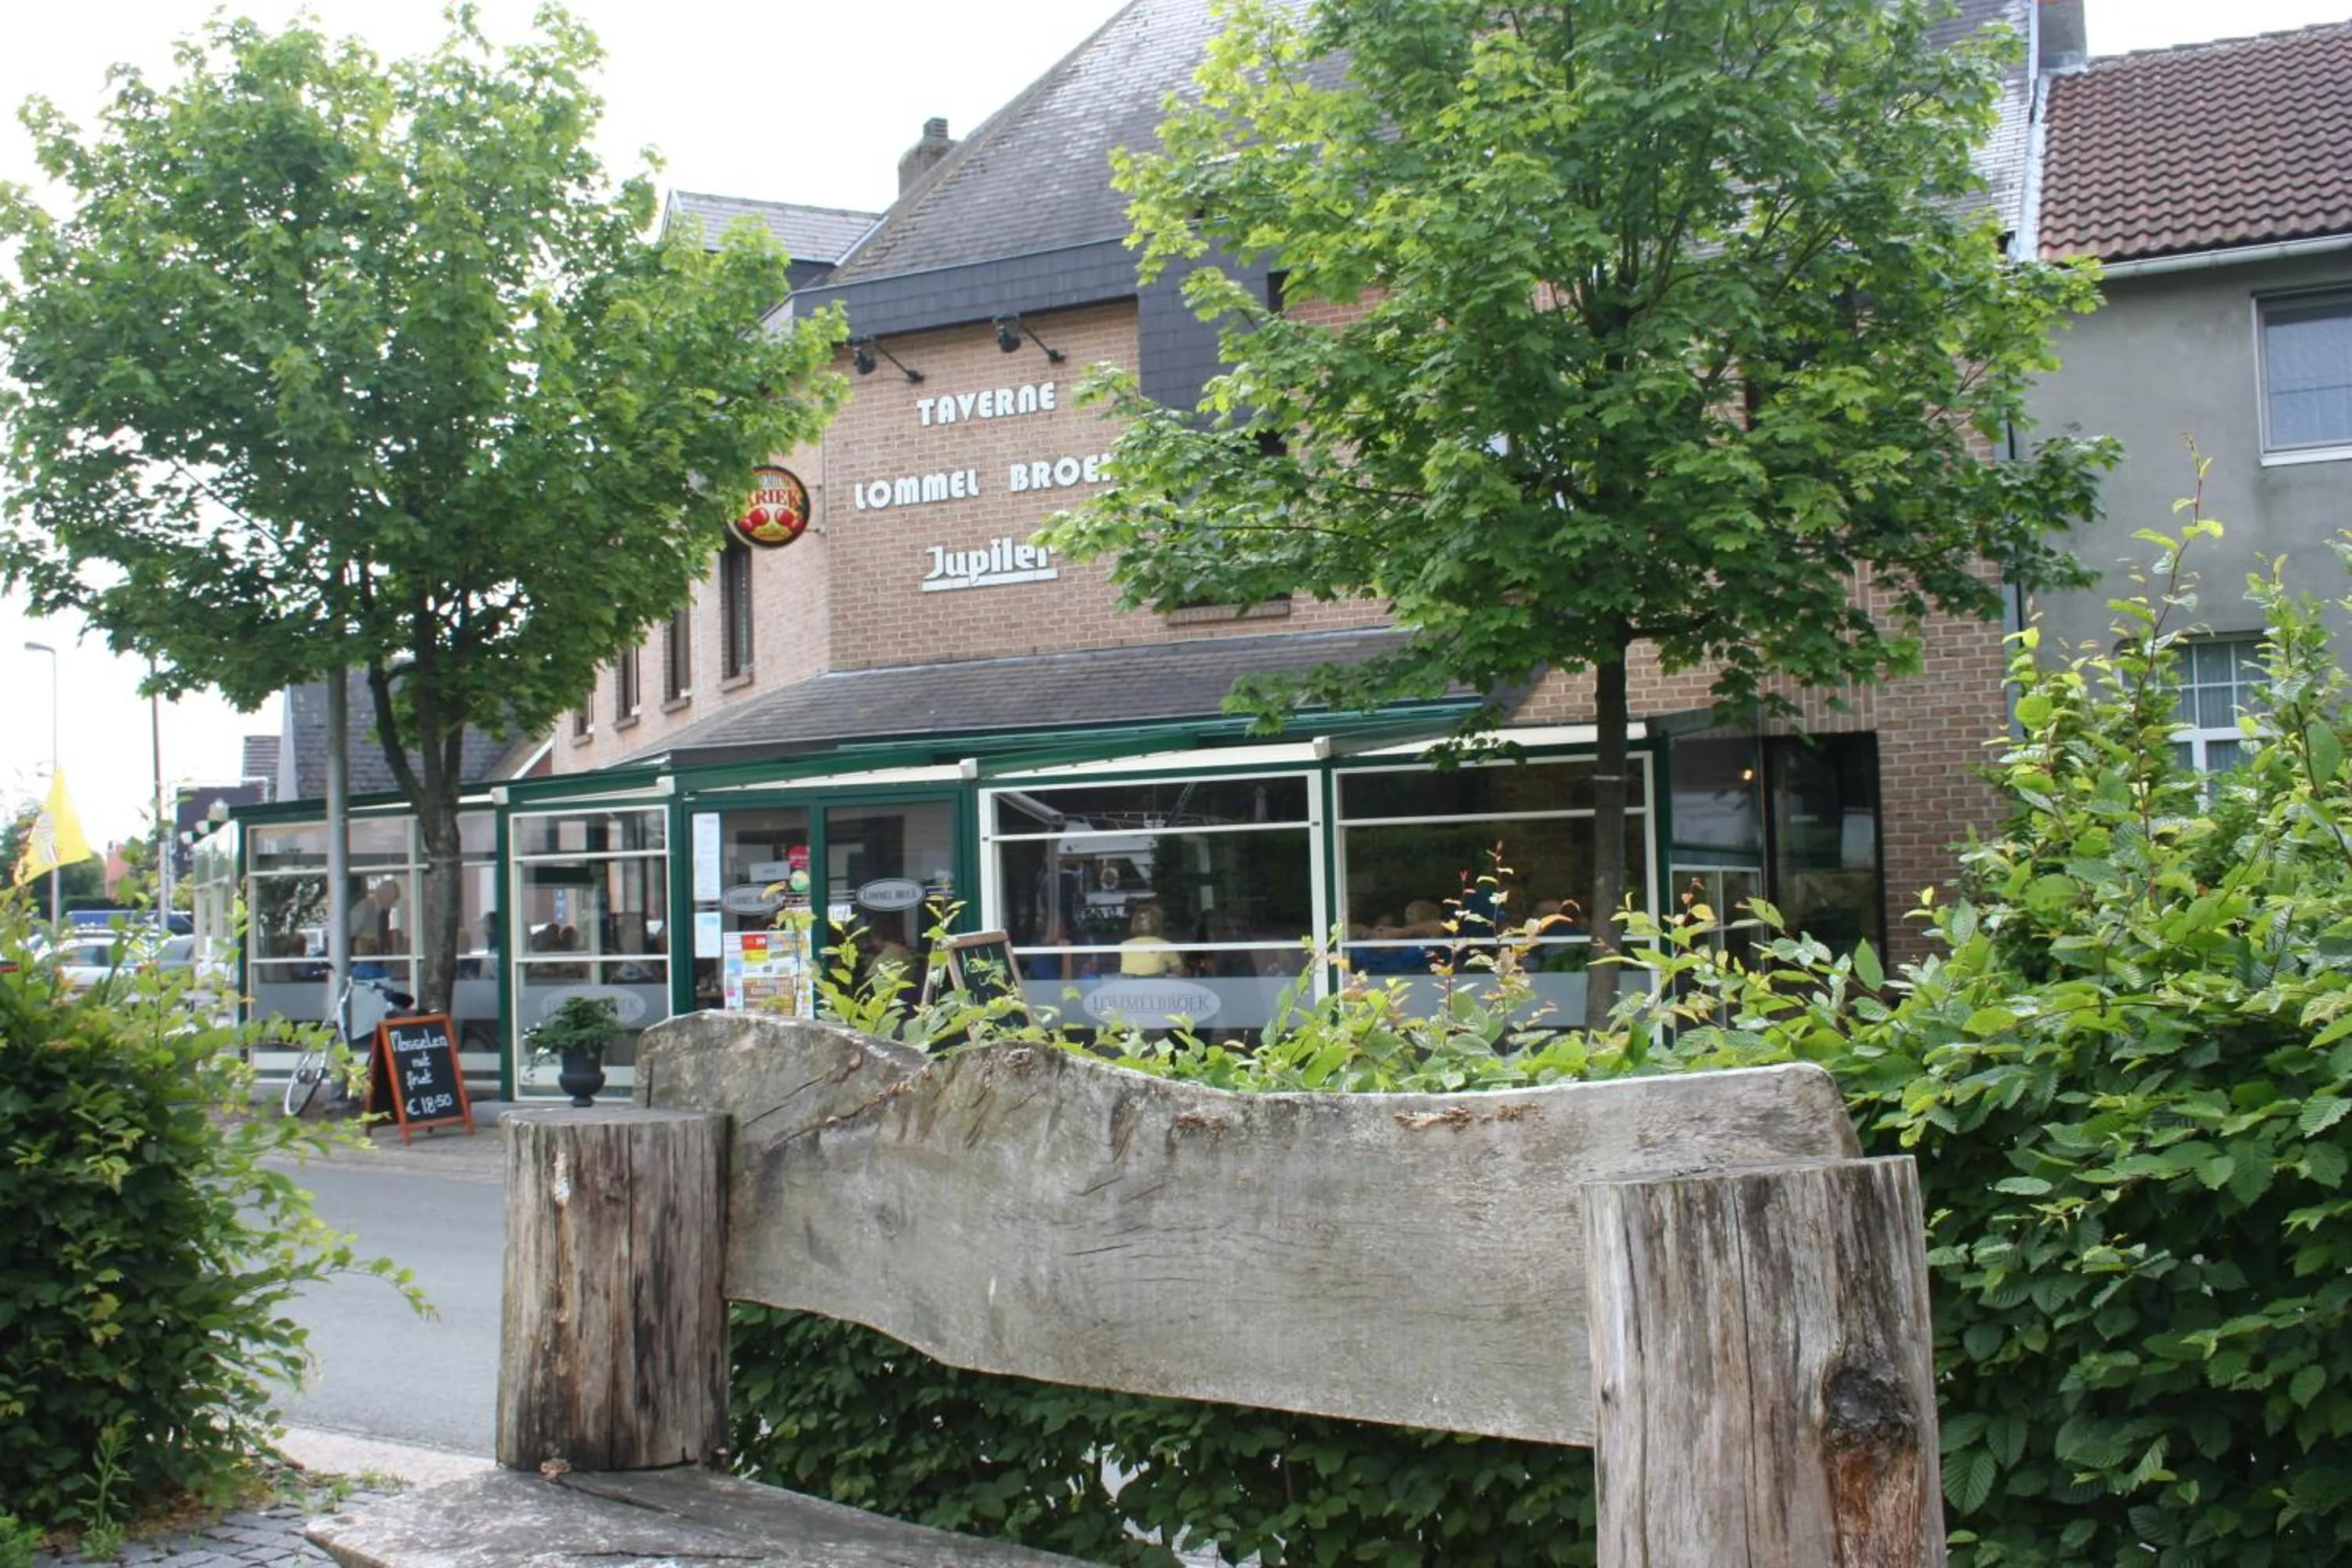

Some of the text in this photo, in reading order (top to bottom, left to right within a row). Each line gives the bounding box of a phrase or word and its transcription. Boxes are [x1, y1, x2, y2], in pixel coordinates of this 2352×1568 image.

[917, 382, 1055, 426] TAVERNE
[855, 469, 979, 510] LOMMEL
[924, 537, 1058, 586] Jupiler
[390, 1029, 448, 1052] Mosselen
